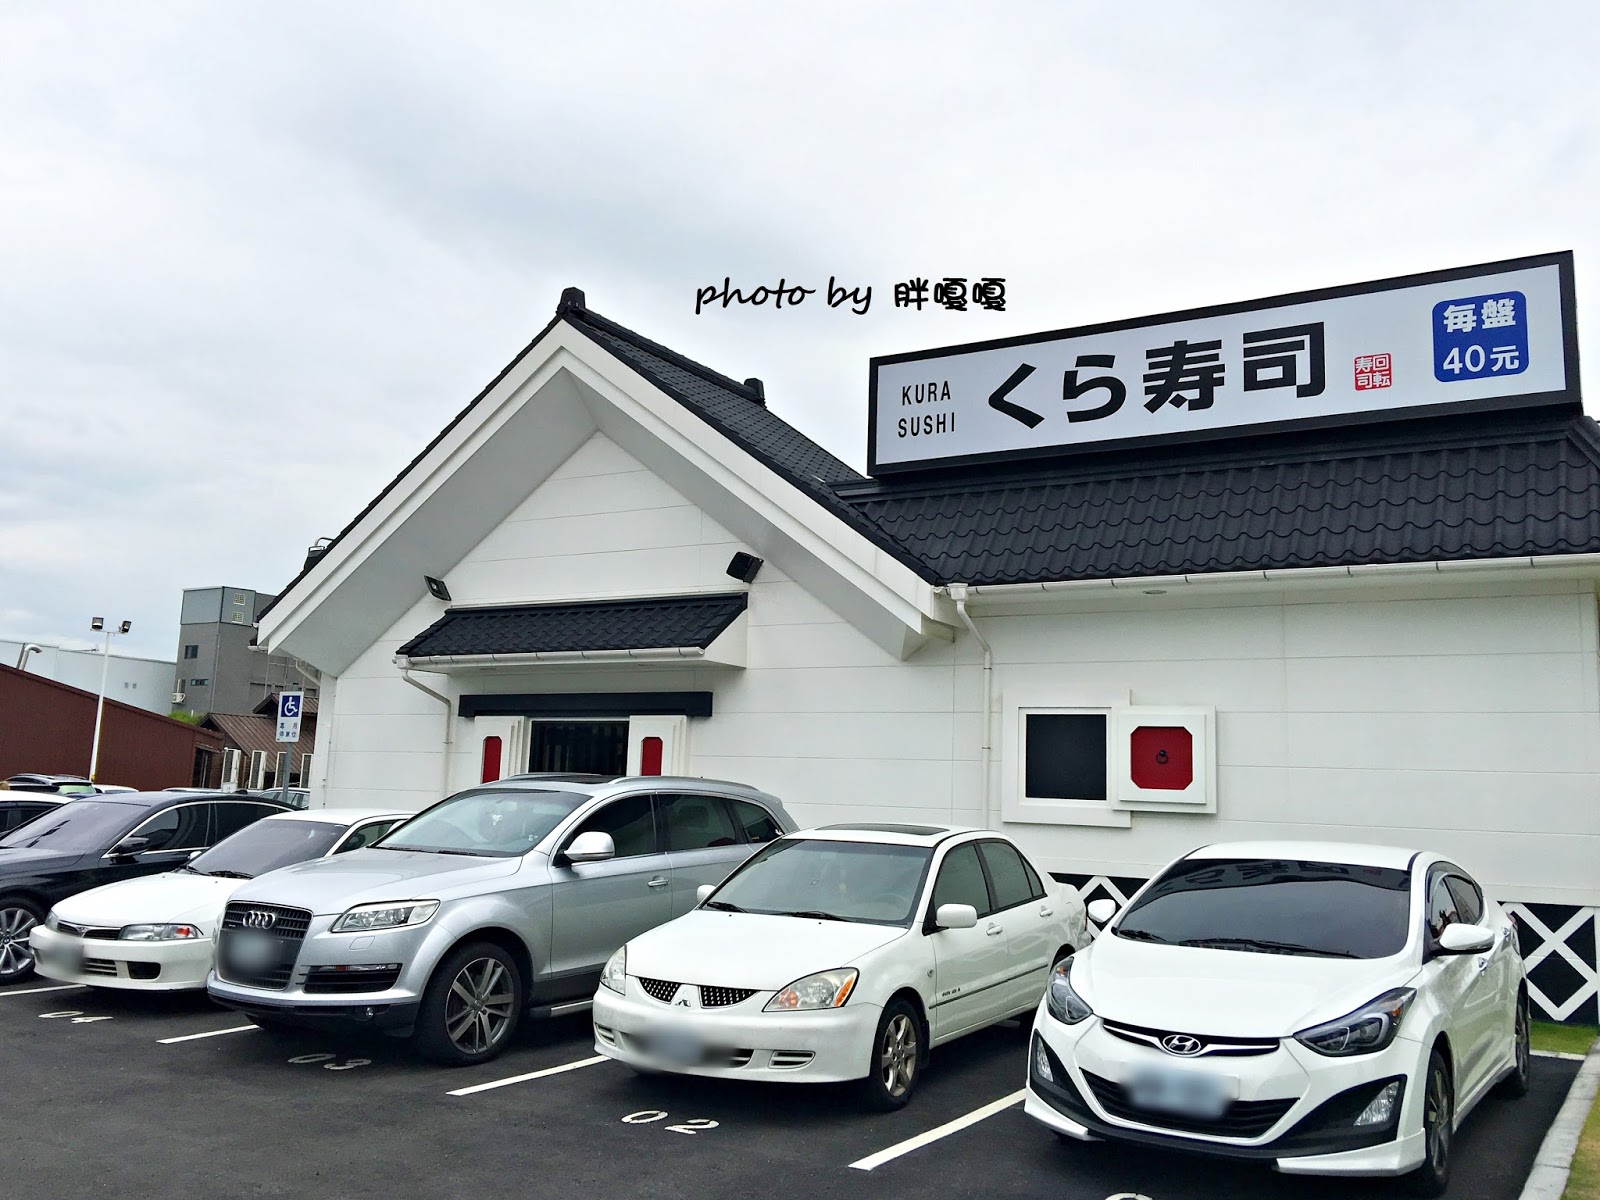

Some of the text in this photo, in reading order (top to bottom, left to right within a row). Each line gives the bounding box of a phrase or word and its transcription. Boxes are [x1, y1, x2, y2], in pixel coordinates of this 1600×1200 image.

[1443, 345, 1519, 374] 40元
[988, 321, 1326, 429] くら寿司
[902, 380, 951, 406] KURA
[898, 412, 955, 438] SUSHI
[38, 1010, 113, 1024] 04
[287, 1053, 372, 1070] 03
[621, 1110, 720, 1135] 02
